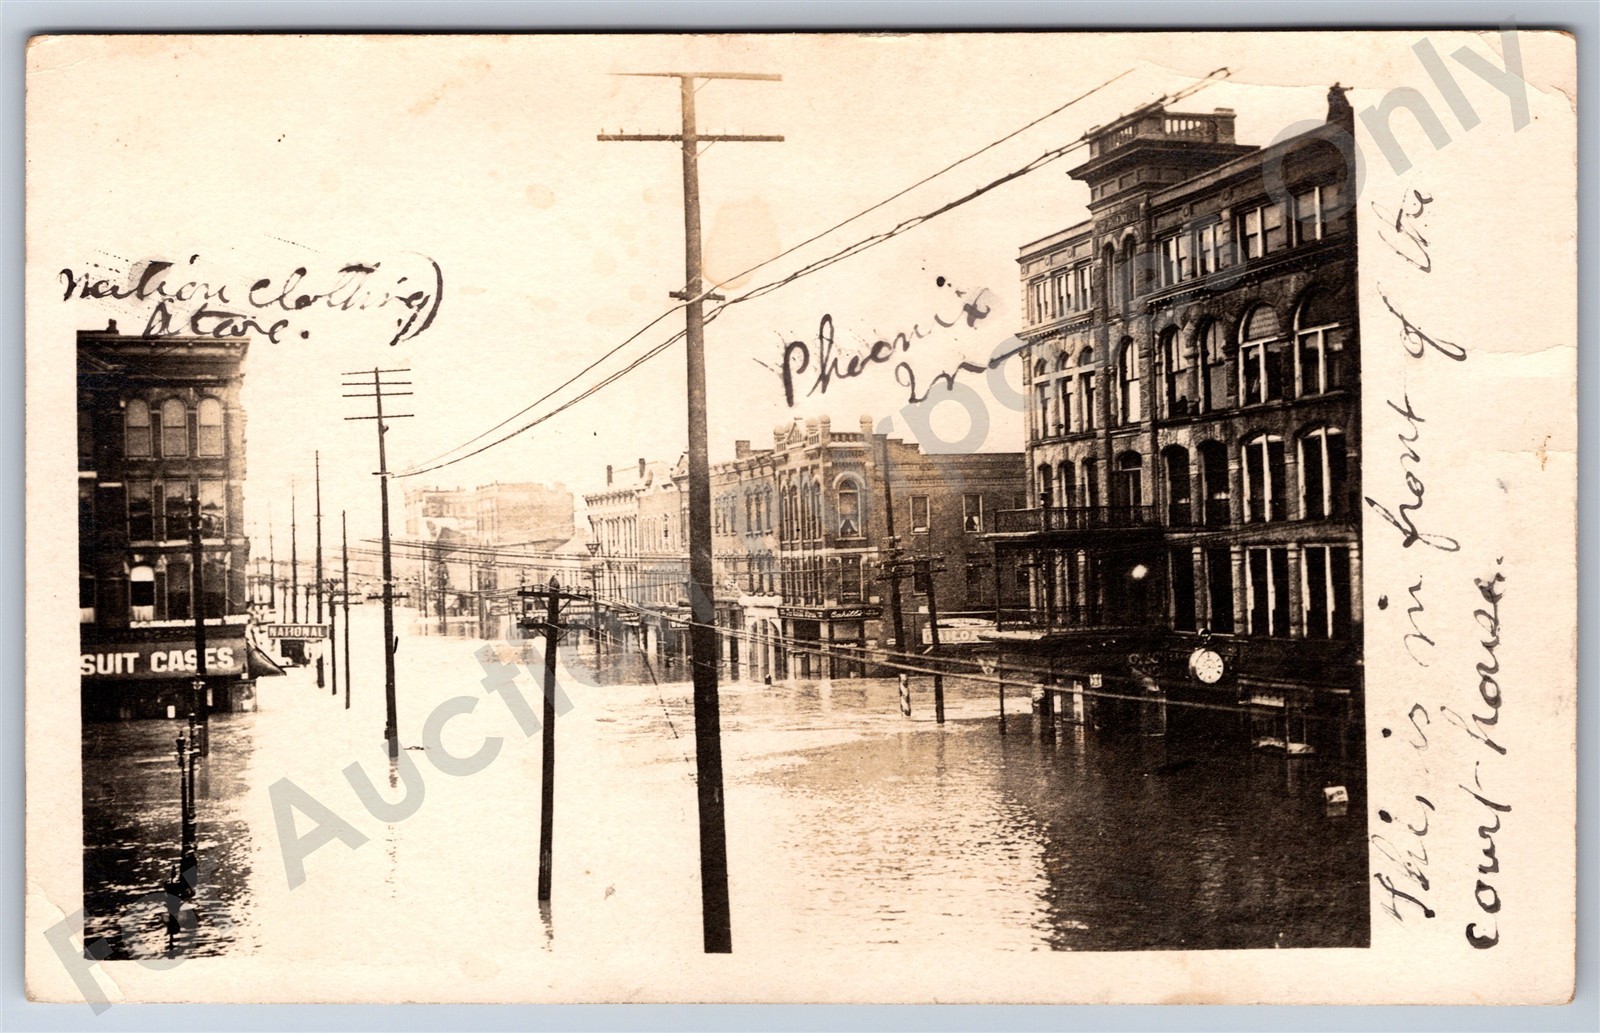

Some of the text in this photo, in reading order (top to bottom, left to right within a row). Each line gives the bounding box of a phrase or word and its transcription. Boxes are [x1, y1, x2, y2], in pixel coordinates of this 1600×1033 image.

[1371, 189, 1434, 273] the
[1376, 282, 1467, 361] of
[1364, 392, 1460, 551] front
[268, 626, 325, 638] NATIONAL
[1377, 575, 1434, 667] in
[80, 647, 234, 676] SUIT CASES
[1381, 702, 1430, 751] is
